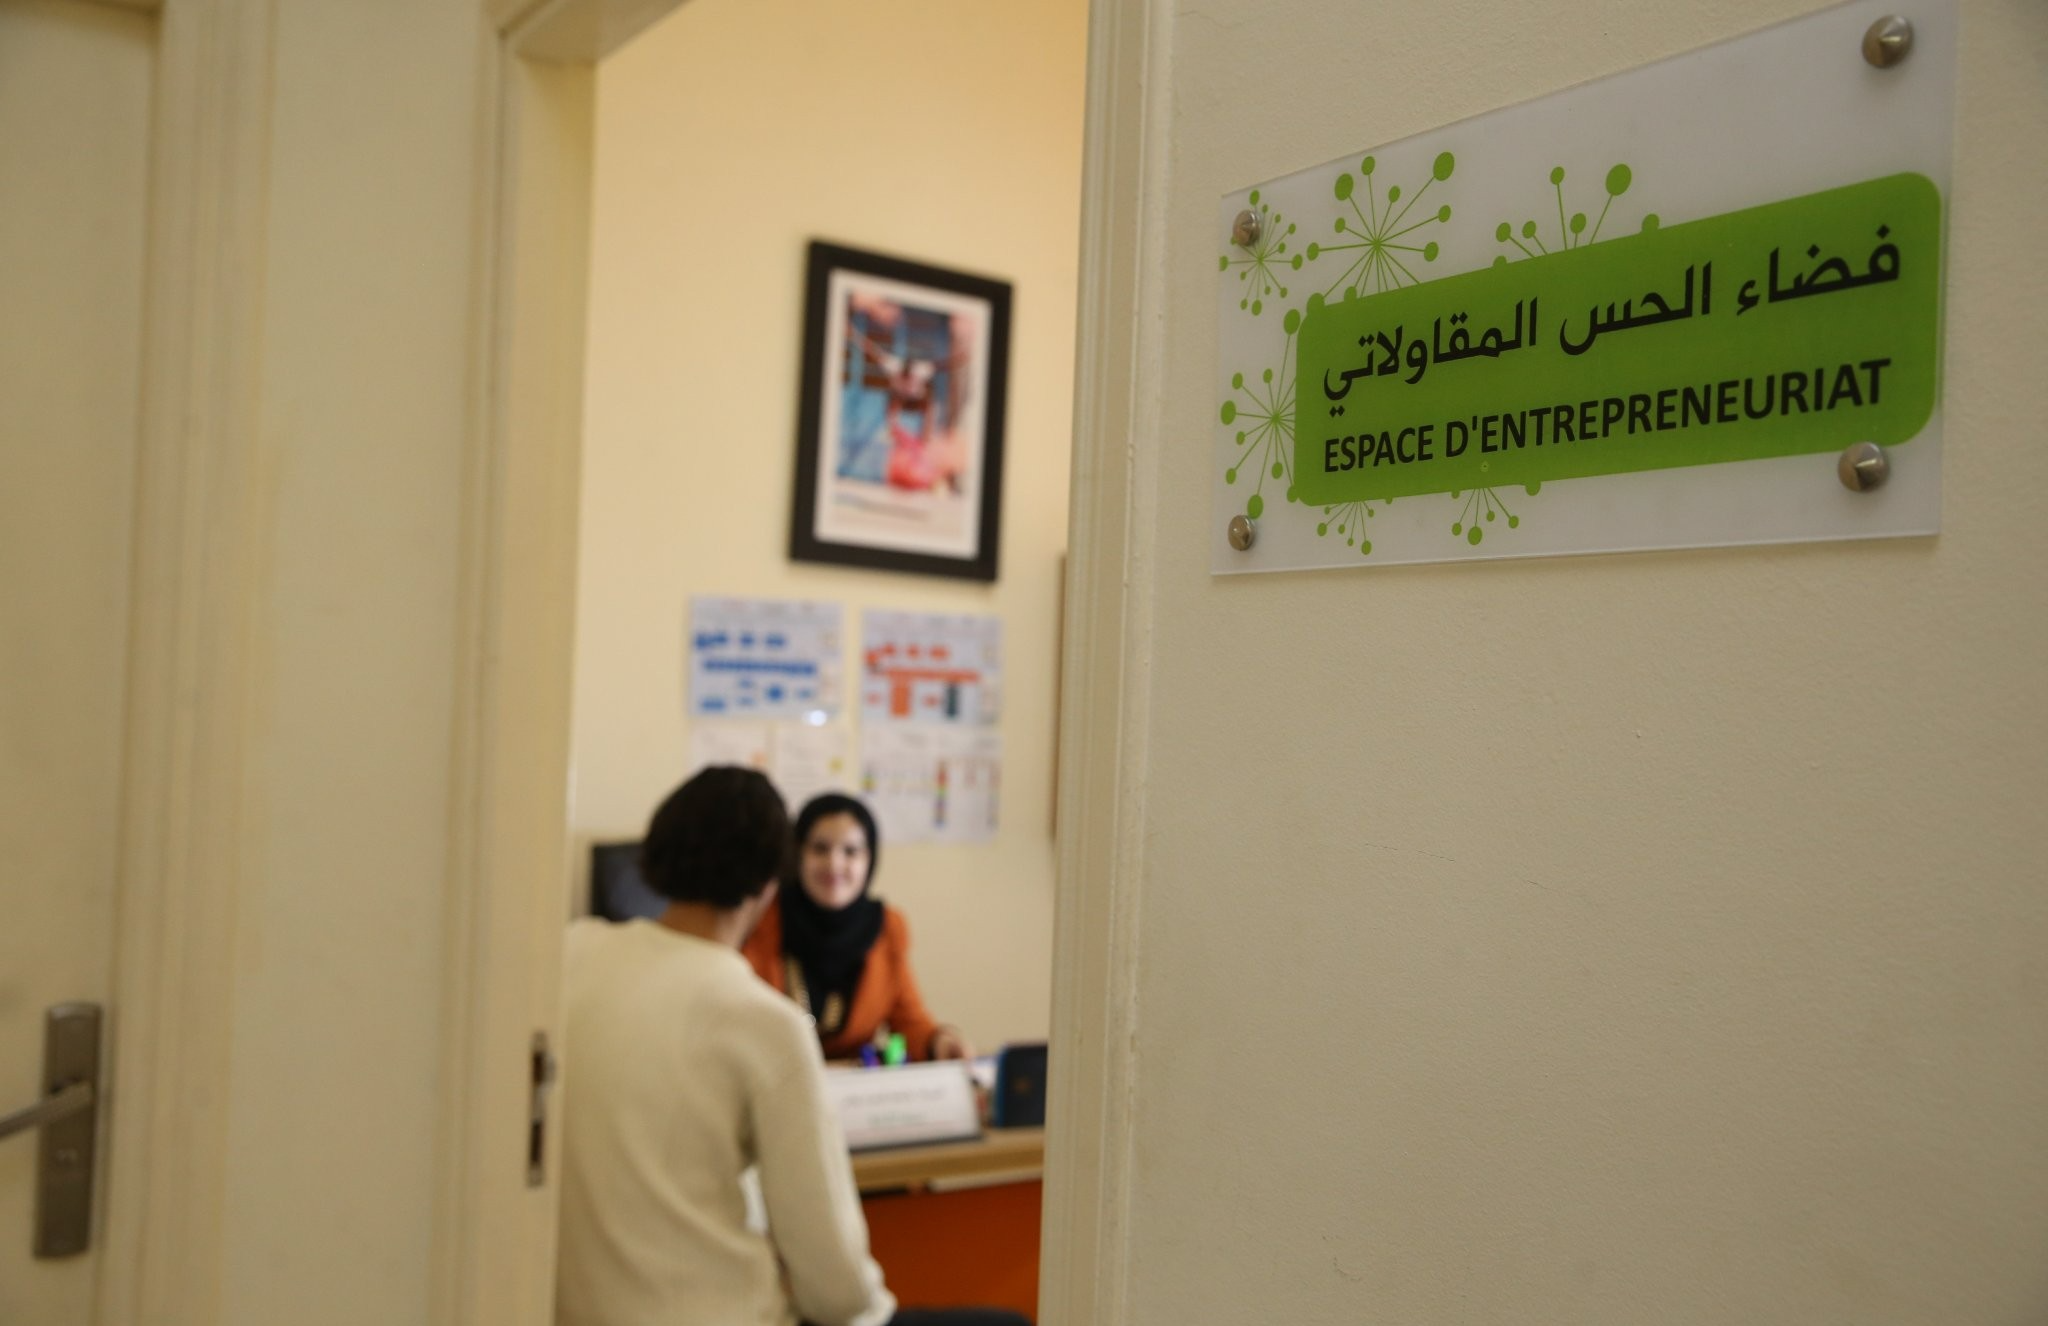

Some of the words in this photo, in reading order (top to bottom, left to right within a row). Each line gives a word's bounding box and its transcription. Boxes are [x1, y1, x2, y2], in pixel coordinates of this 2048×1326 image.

[1559, 261, 1712, 355] الحس
[1736, 224, 1901, 316] فضاء
[1323, 297, 1538, 417] المقاولاتي
[1324, 424, 1434, 473] ESPACE
[1445, 358, 1891, 457] D'ENTREPRENEURIAT
